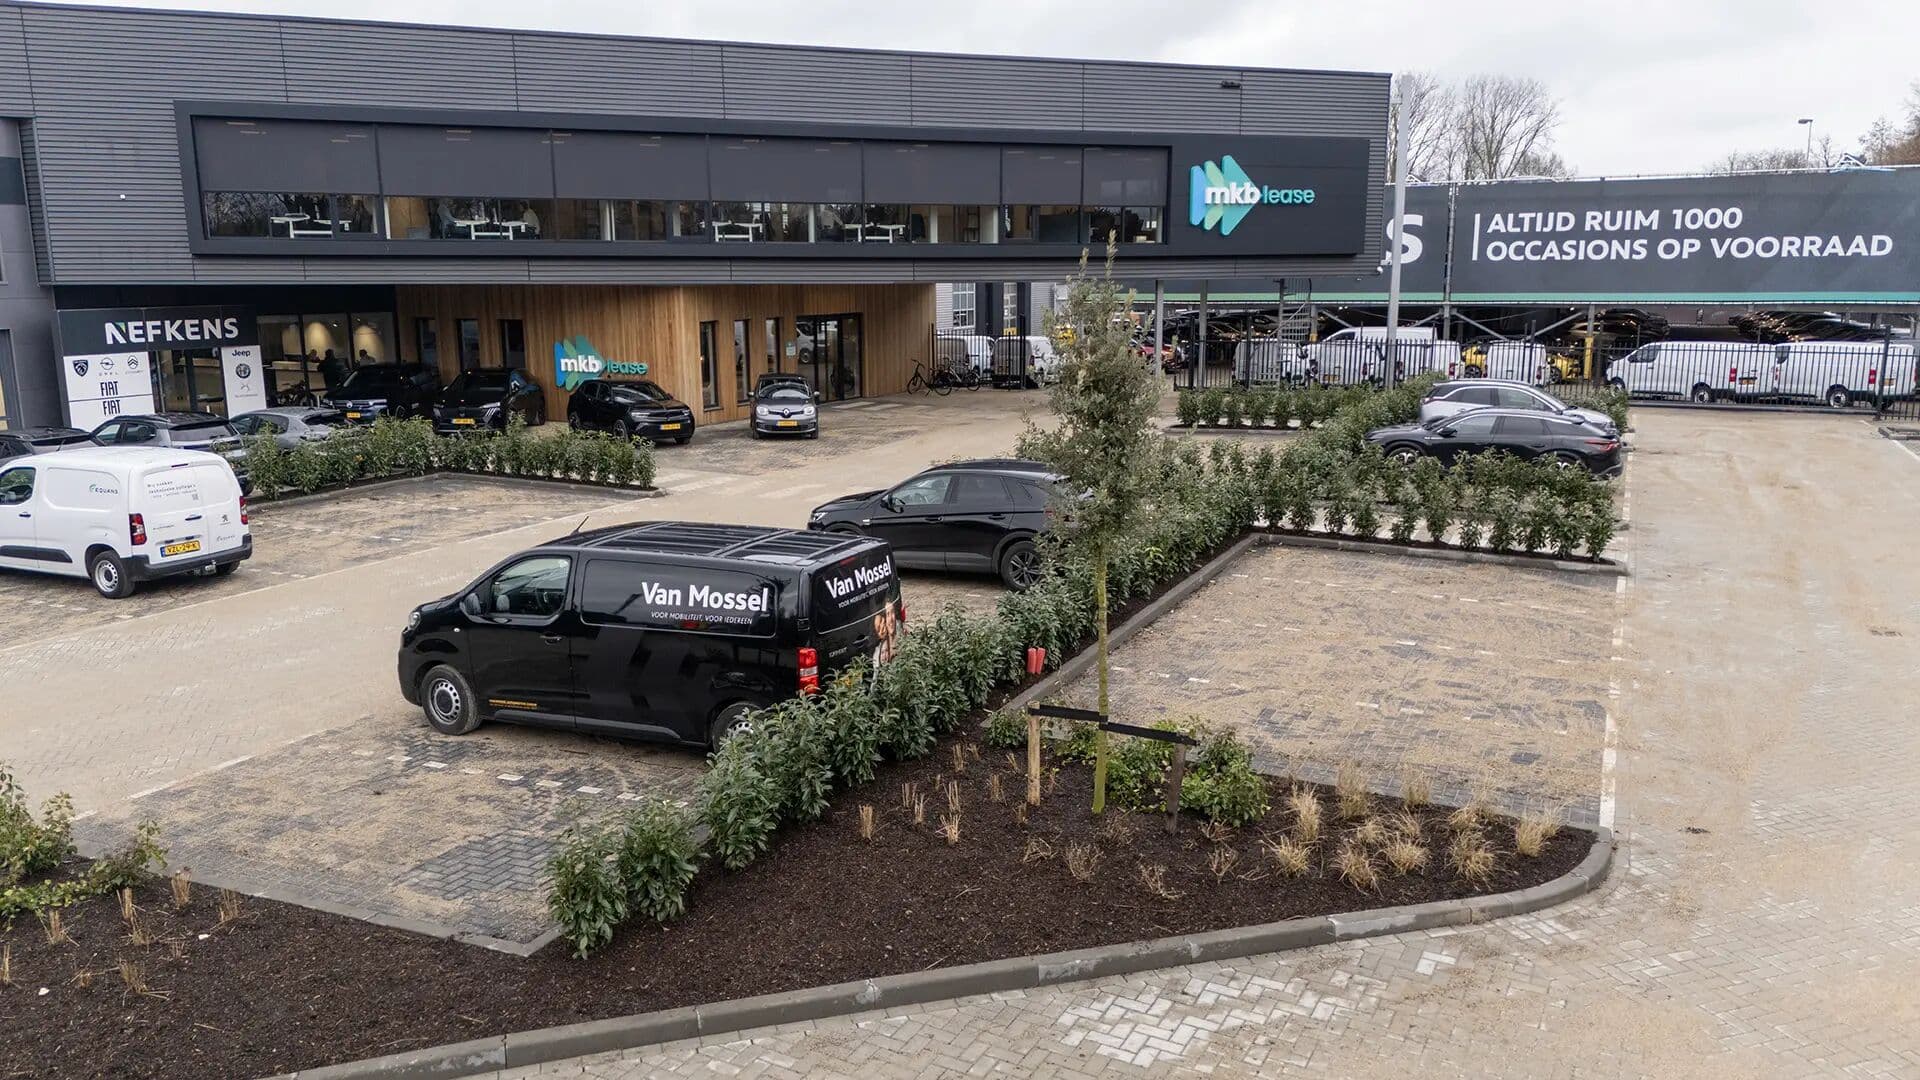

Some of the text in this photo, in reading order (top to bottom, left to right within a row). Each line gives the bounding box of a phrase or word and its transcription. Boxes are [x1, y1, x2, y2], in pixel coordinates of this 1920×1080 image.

[1204, 182, 1315, 205] mkb lease
[1486, 207, 1743, 233] ALTIJD RUIM 1000
[1486, 235, 1893, 261] OCCASIONS OP VOORRAAD
[104, 318, 239, 345] NEFKENS
[232, 349, 251, 357] Jeep
[560, 355, 648, 374] mkb lease
[100, 381, 118, 397] FIAT
[102, 399, 121, 416] FIAT
[825, 555, 892, 599] Van Mossel
[641, 581, 769, 612] Van Mossel
[651, 611, 669, 619] VOOR
